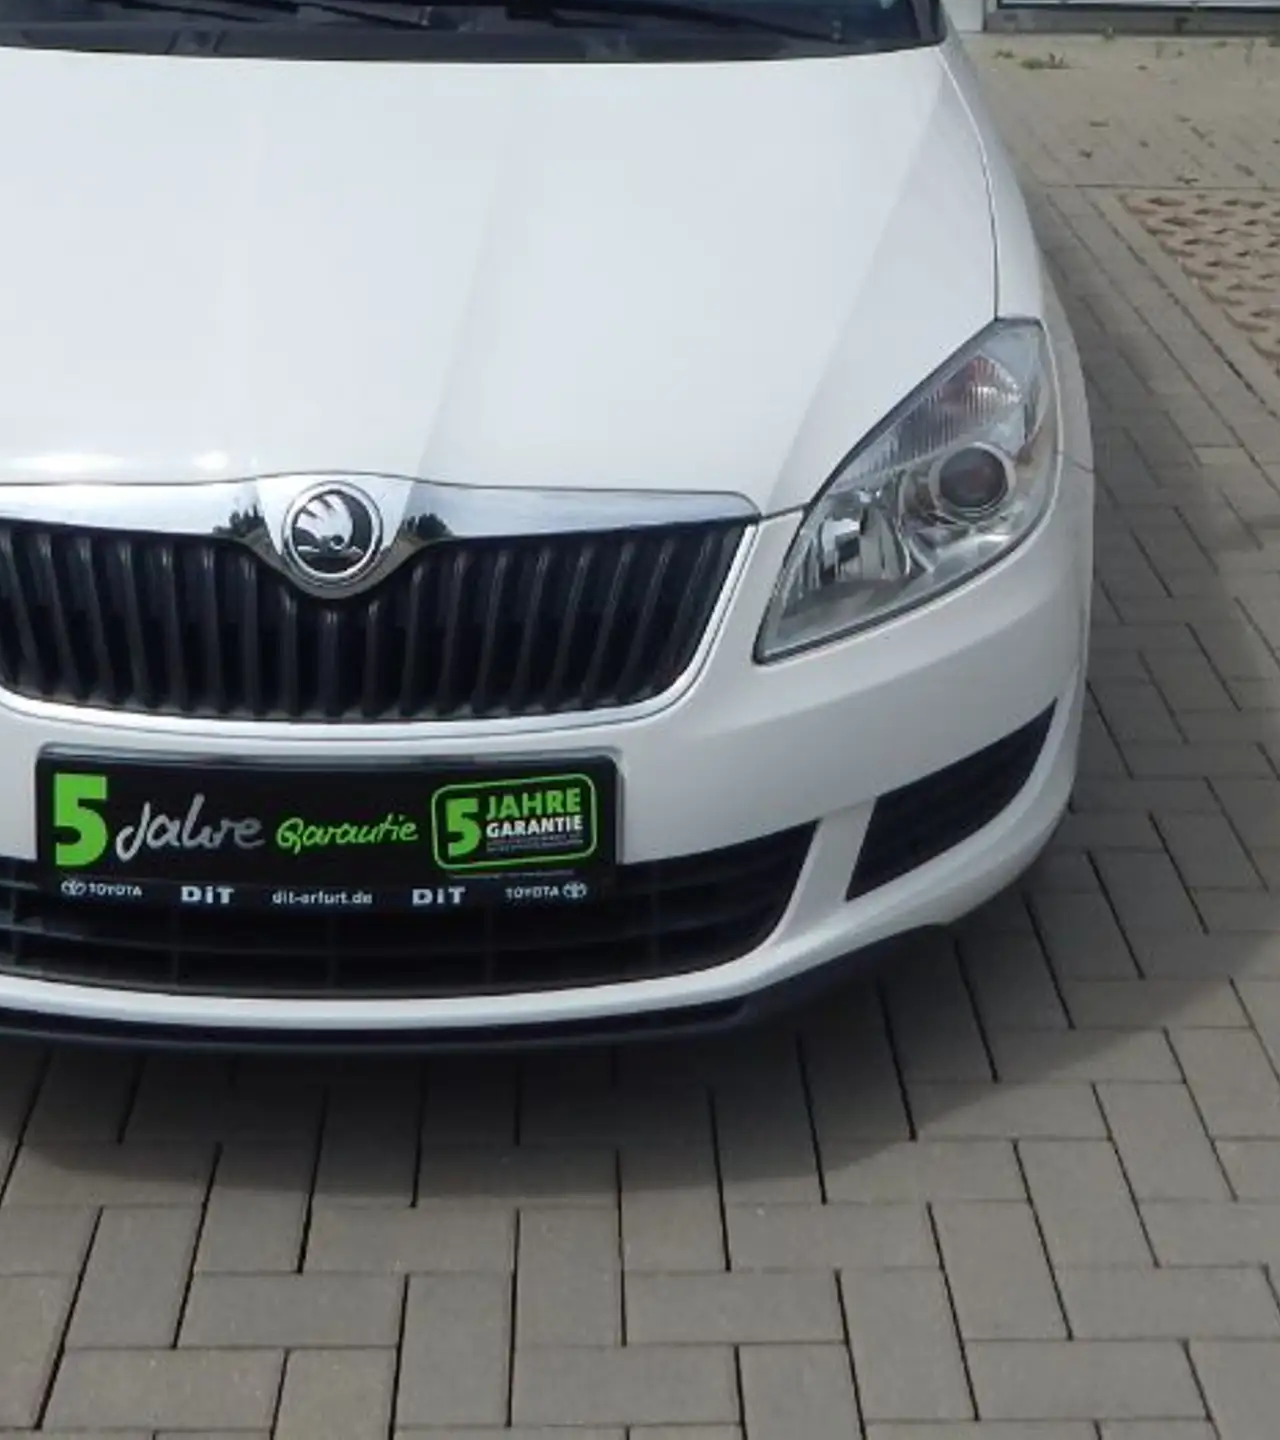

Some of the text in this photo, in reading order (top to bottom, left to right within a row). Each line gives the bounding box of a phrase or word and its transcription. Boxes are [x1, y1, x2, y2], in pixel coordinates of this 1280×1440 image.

[485, 787, 582, 821] JAHRE
[54, 772, 420, 867] 5 Jahre Garantie
[445, 797, 482, 859] 5
[485, 814, 584, 838] GARANTIE
[88, 882, 143, 897] TOYOTA
[271, 890, 373, 905] dit-erfurt.de
[505, 883, 560, 900] TOYOTA
